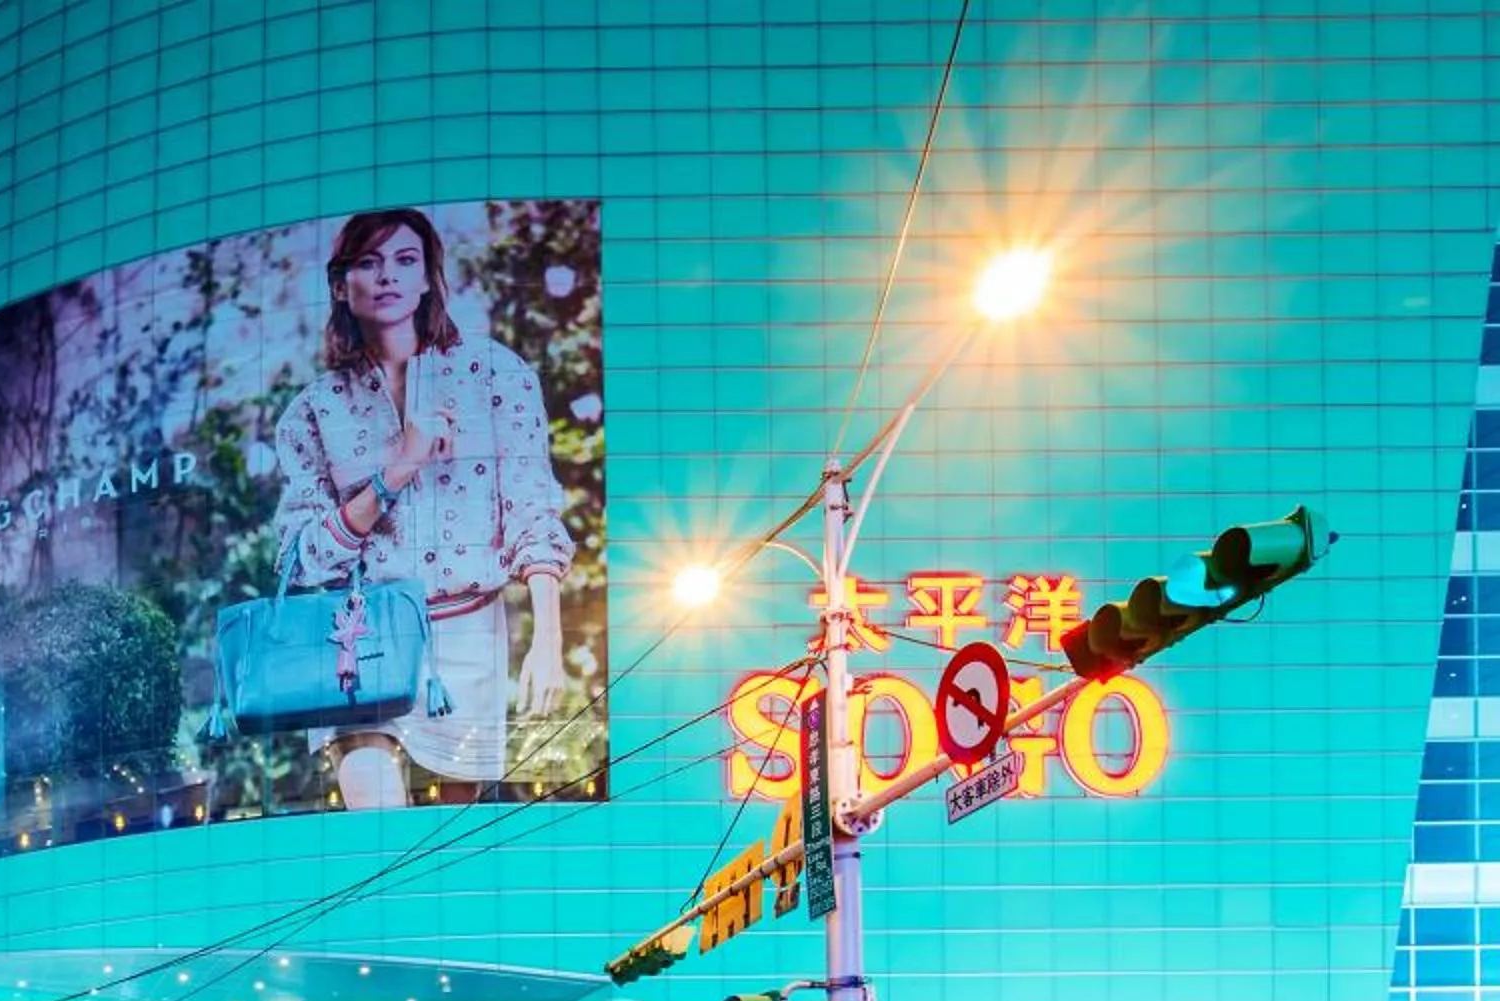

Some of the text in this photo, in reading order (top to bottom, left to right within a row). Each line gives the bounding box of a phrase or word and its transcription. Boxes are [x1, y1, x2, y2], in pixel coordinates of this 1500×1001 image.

[807, 571, 1087, 655] 太平洋
[950, 760, 1015, 816] 大客車除外
